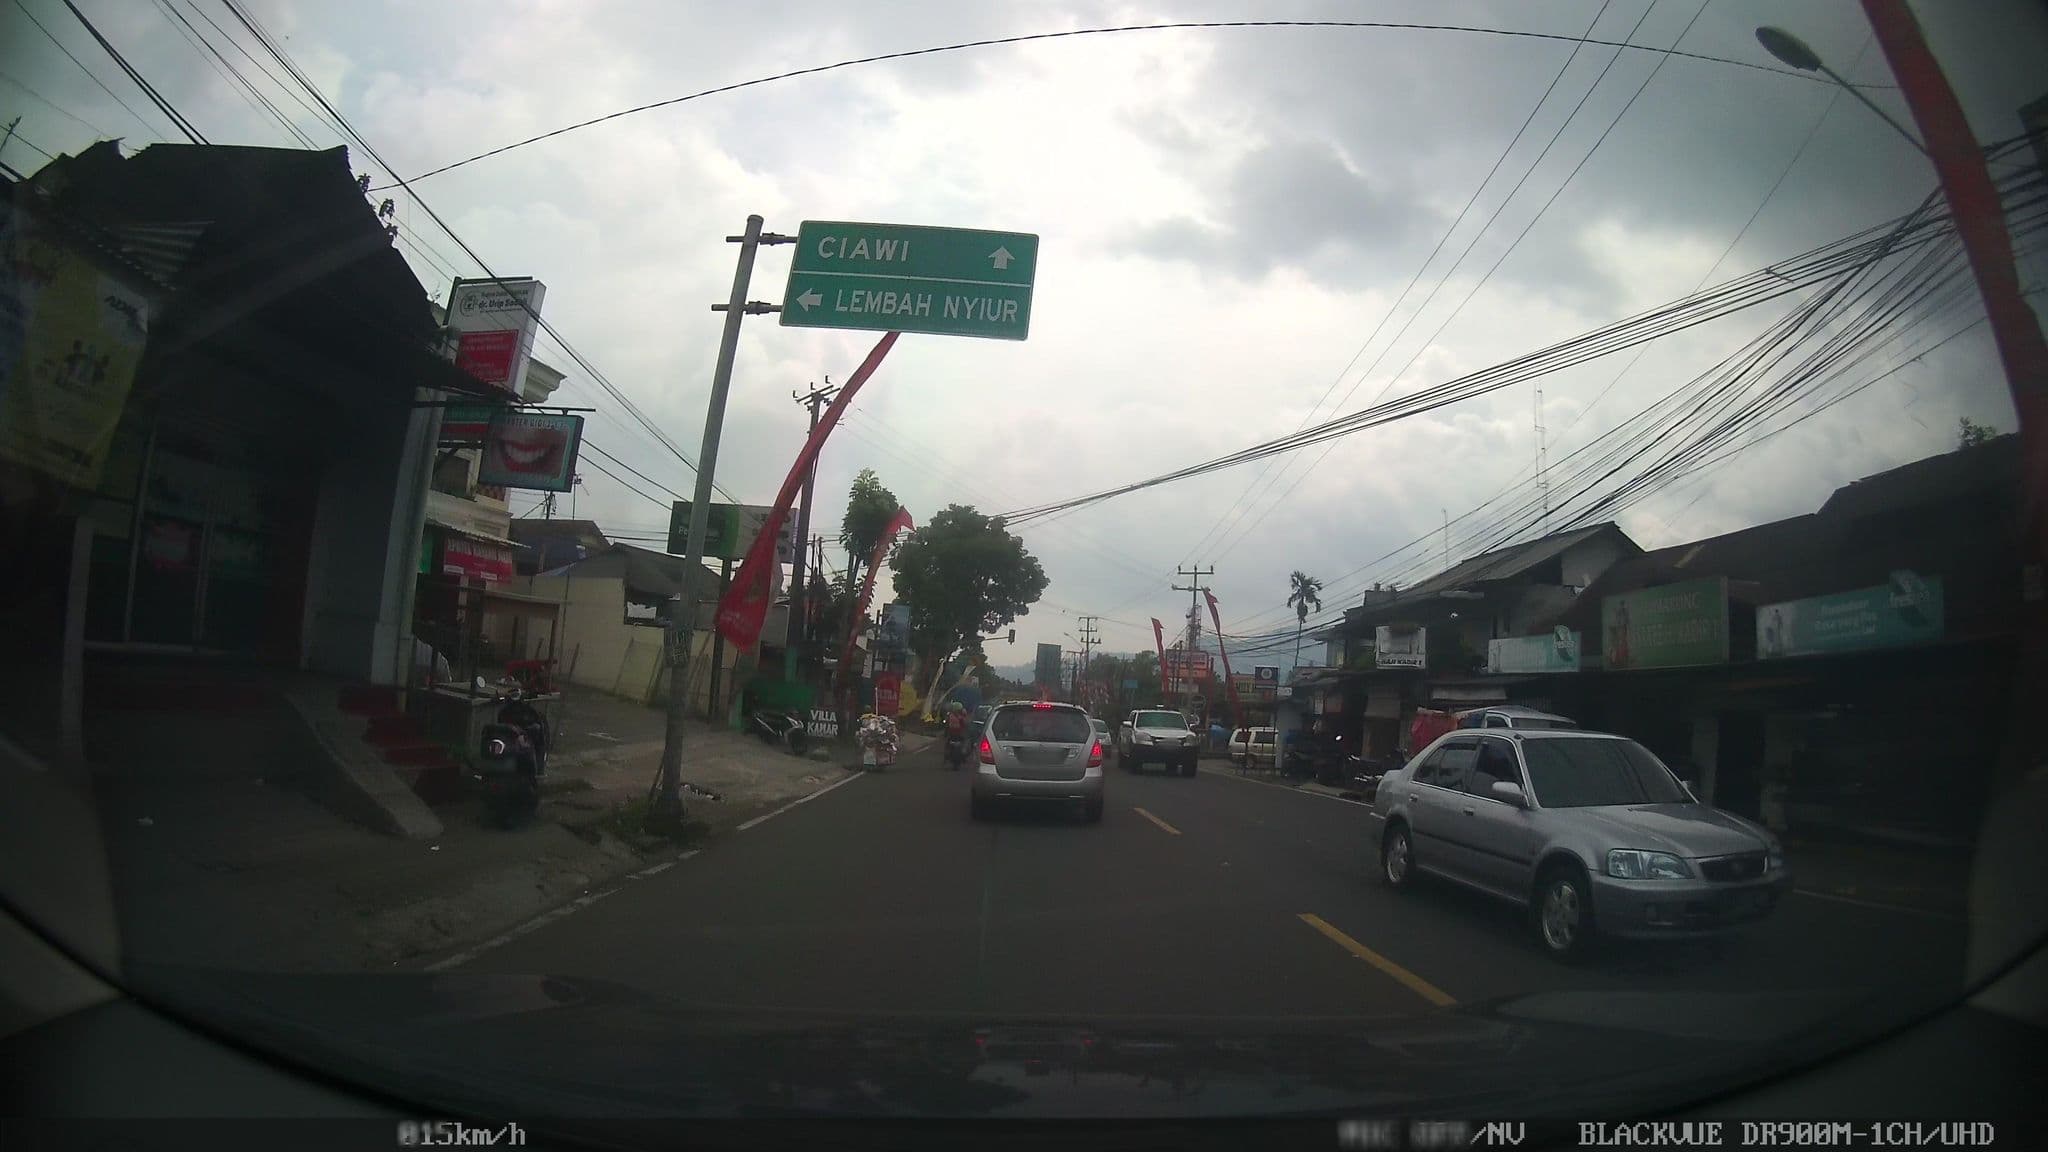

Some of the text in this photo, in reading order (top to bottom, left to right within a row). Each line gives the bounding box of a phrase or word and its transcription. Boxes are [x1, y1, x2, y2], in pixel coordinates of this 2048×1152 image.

[817, 236, 909, 262] CIAWI
[835, 289, 1018, 323] LEMBAH NYIUR
[810, 709, 837, 722] VILLA
[807, 721, 839, 736] KAMAR
